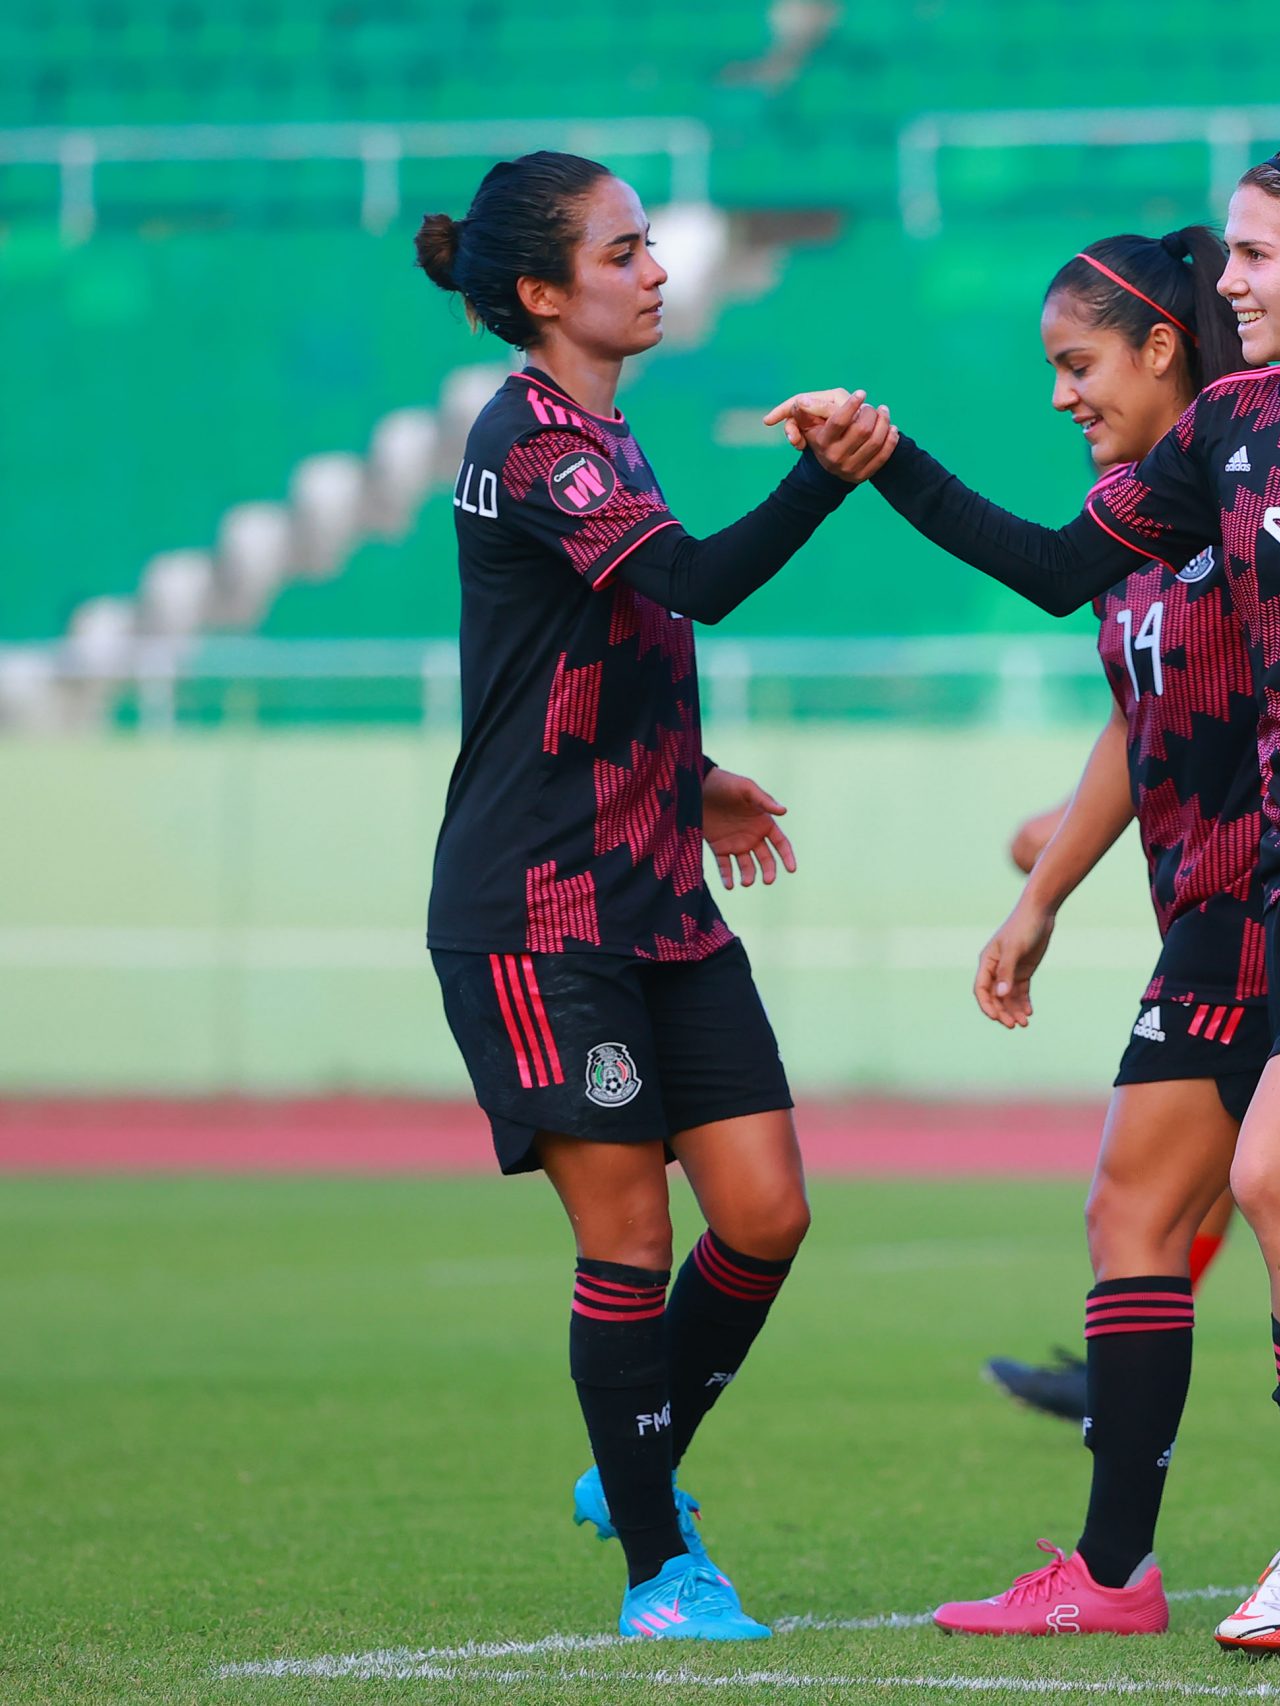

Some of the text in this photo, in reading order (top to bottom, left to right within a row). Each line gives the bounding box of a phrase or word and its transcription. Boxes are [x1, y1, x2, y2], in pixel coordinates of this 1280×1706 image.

[1225, 462, 1251, 472] adidas
[1117, 601, 1164, 702] 14
[1133, 1024, 1166, 1042] adidas
[636, 1400, 671, 1436] FM
